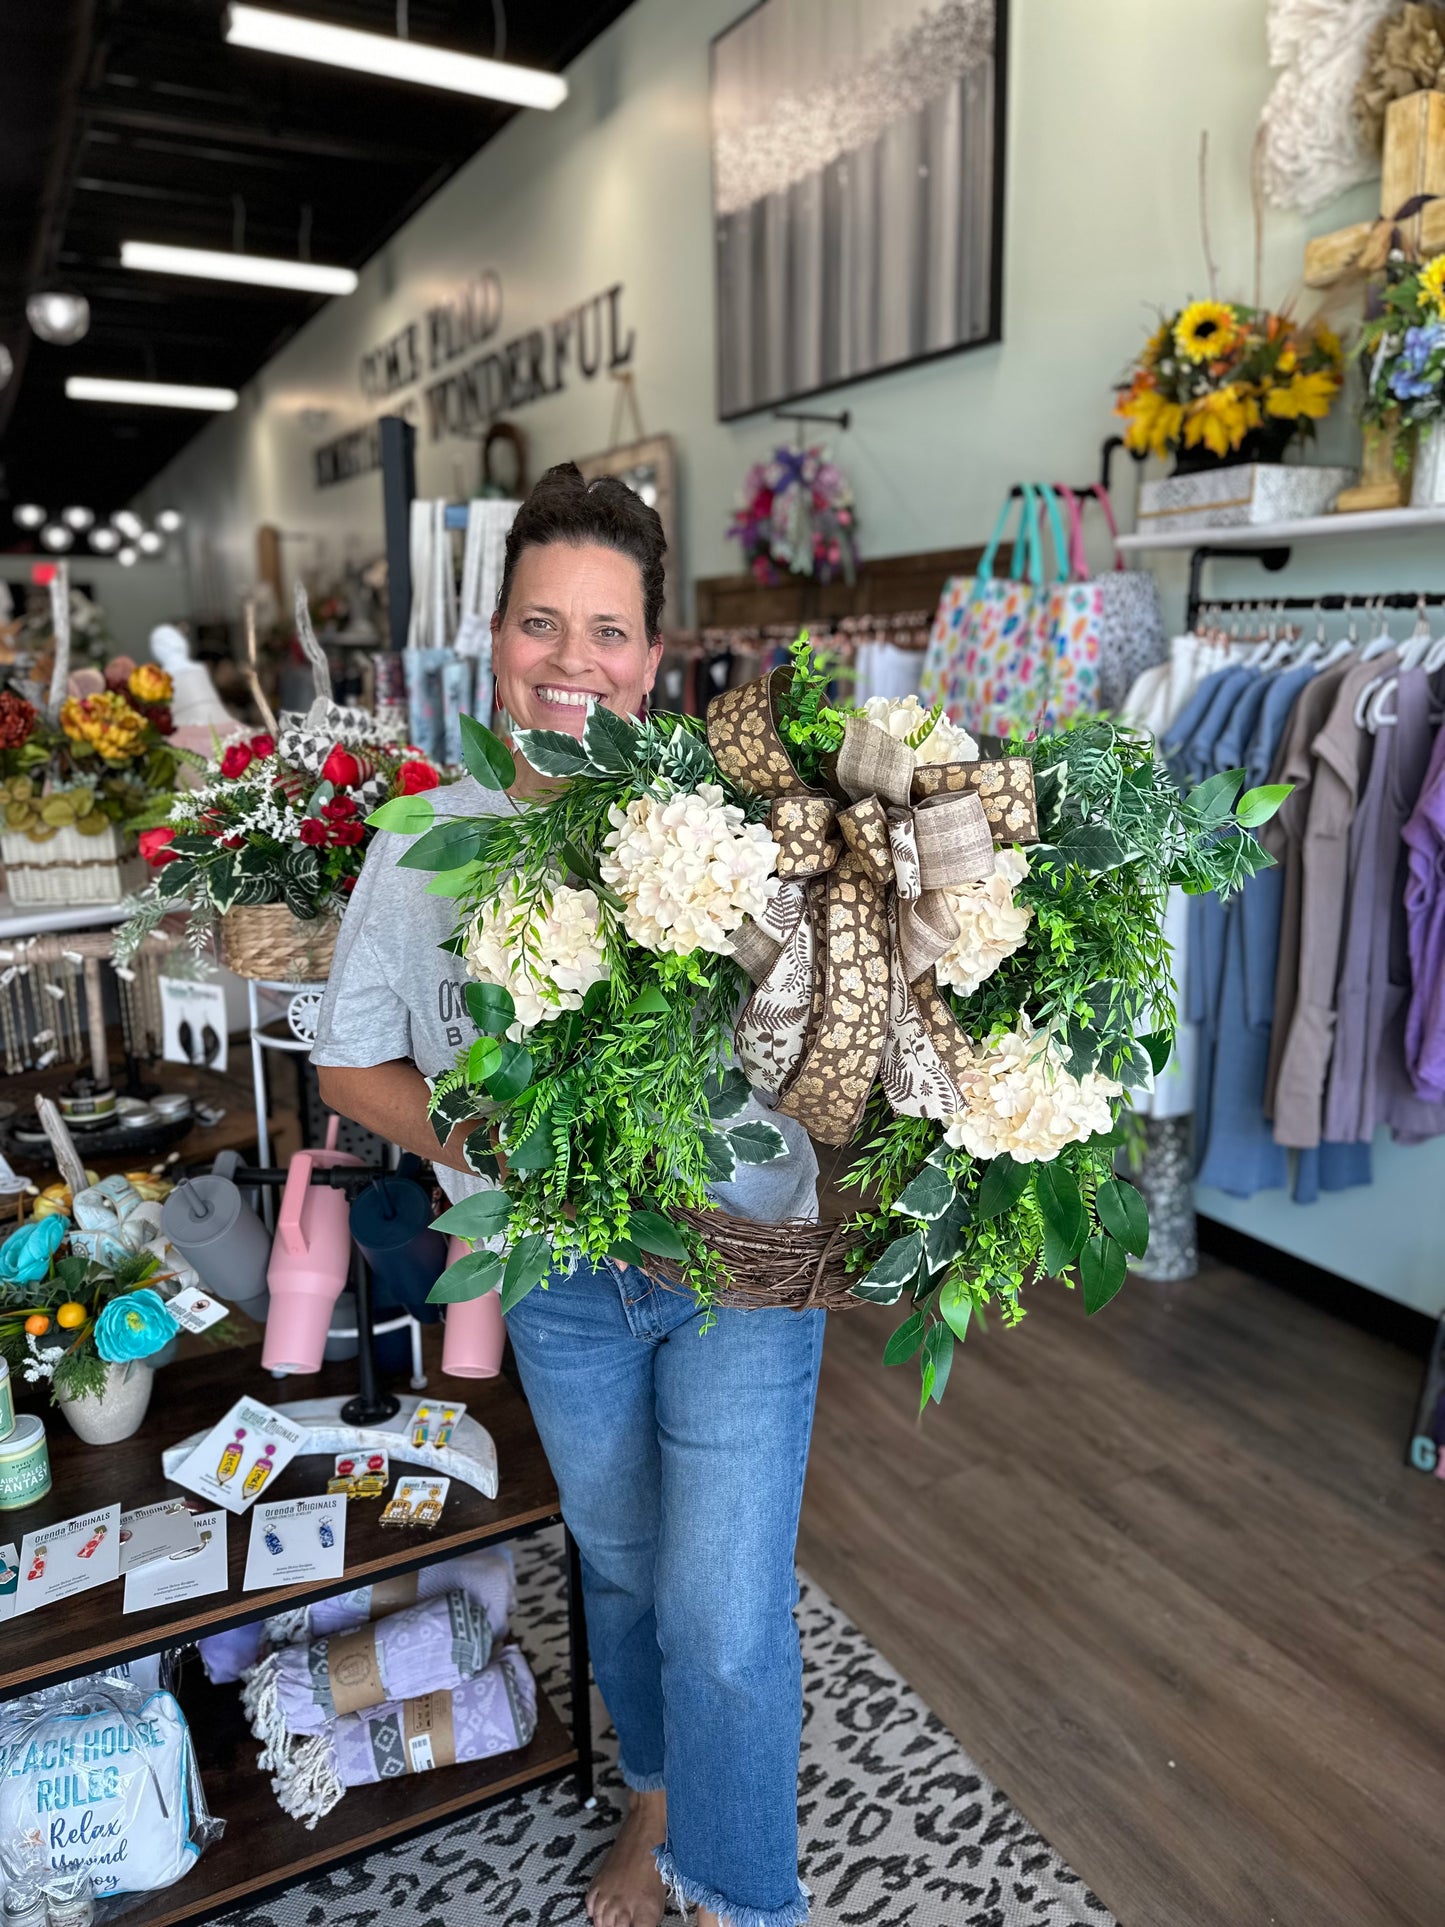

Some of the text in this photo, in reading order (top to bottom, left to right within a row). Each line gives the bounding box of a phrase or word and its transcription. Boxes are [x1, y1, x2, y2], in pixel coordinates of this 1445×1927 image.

[0, 1475, 19, 1485] AIRY
[265, 1500, 337, 1518] Orenda ORIGINALS
[34, 1512, 110, 1544] Orenda ORIGINALS
[83, 1717, 166, 1763] HOUSE
[37, 1765, 120, 1814] RULES
[50, 1809, 122, 1850] Relax
